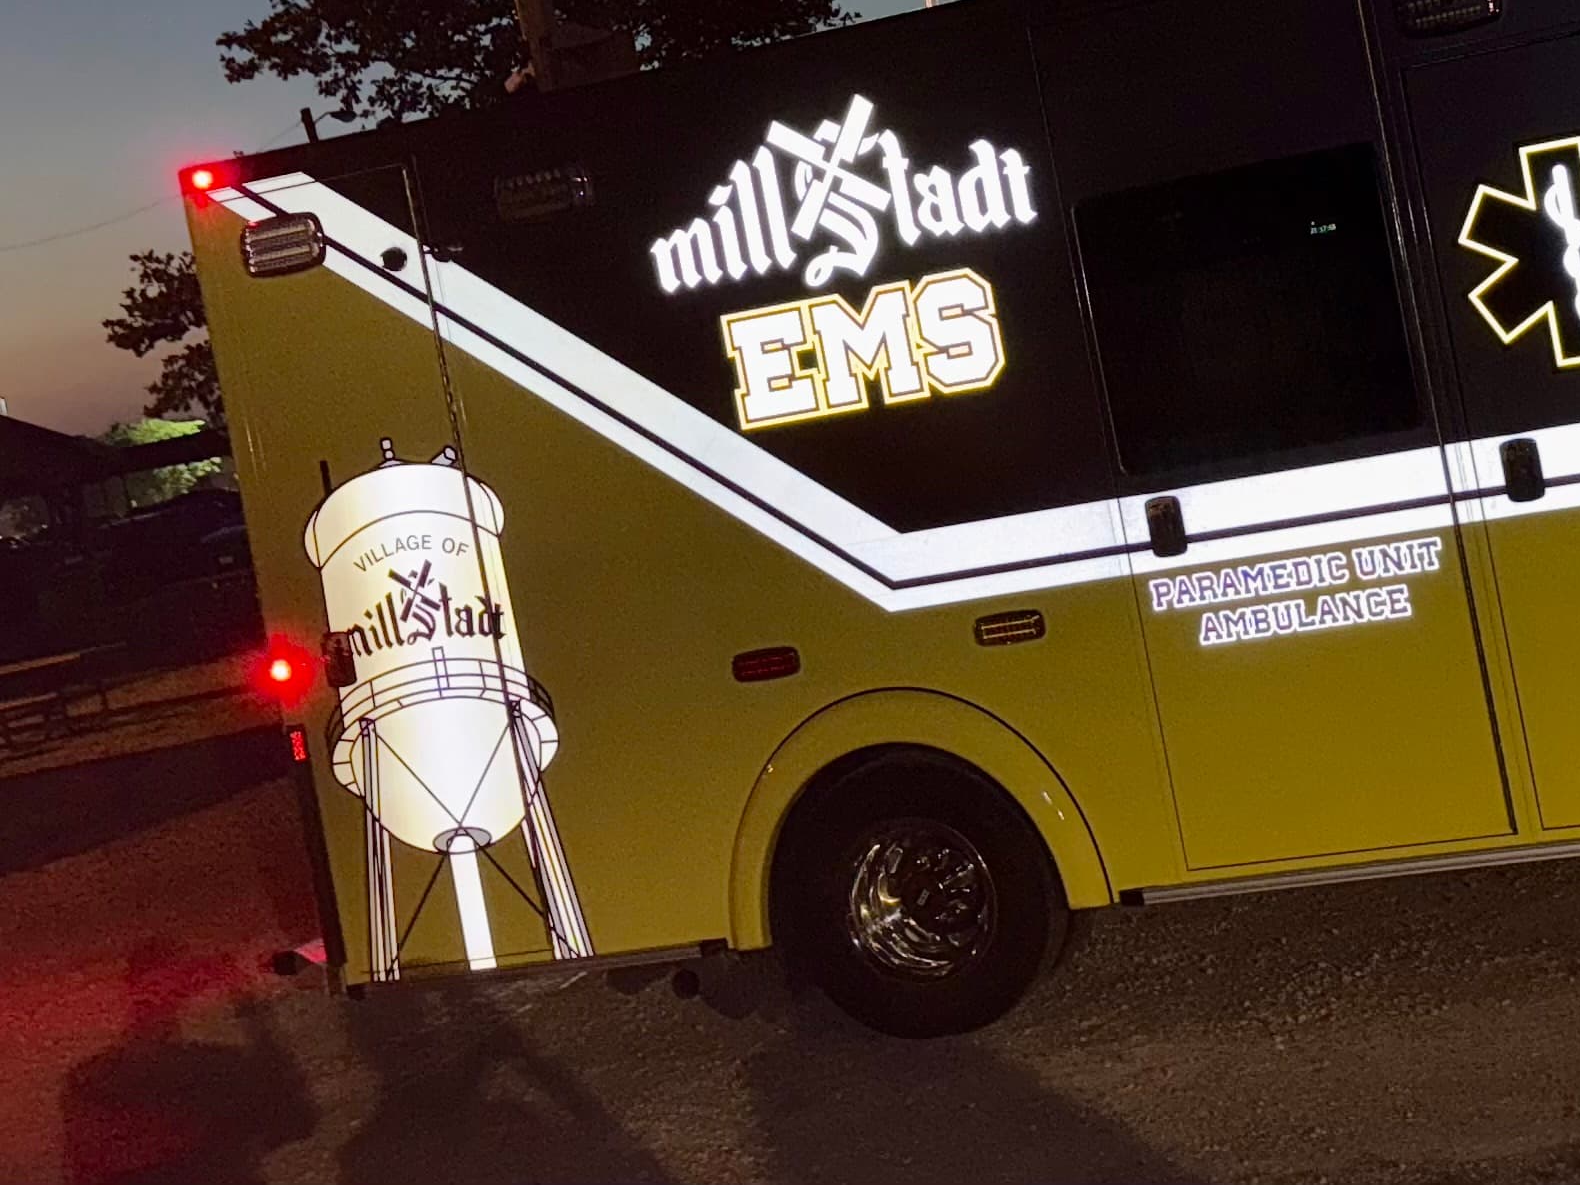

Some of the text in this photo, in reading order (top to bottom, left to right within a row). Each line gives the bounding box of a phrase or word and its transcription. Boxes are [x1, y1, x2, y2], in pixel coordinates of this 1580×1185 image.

[720, 267, 1006, 431] EMS
[353, 534, 470, 572] VILLAGE OF
[1149, 537, 1442, 611] PARAMEDIC UNIT
[1199, 584, 1412, 646] AMBULANCE
